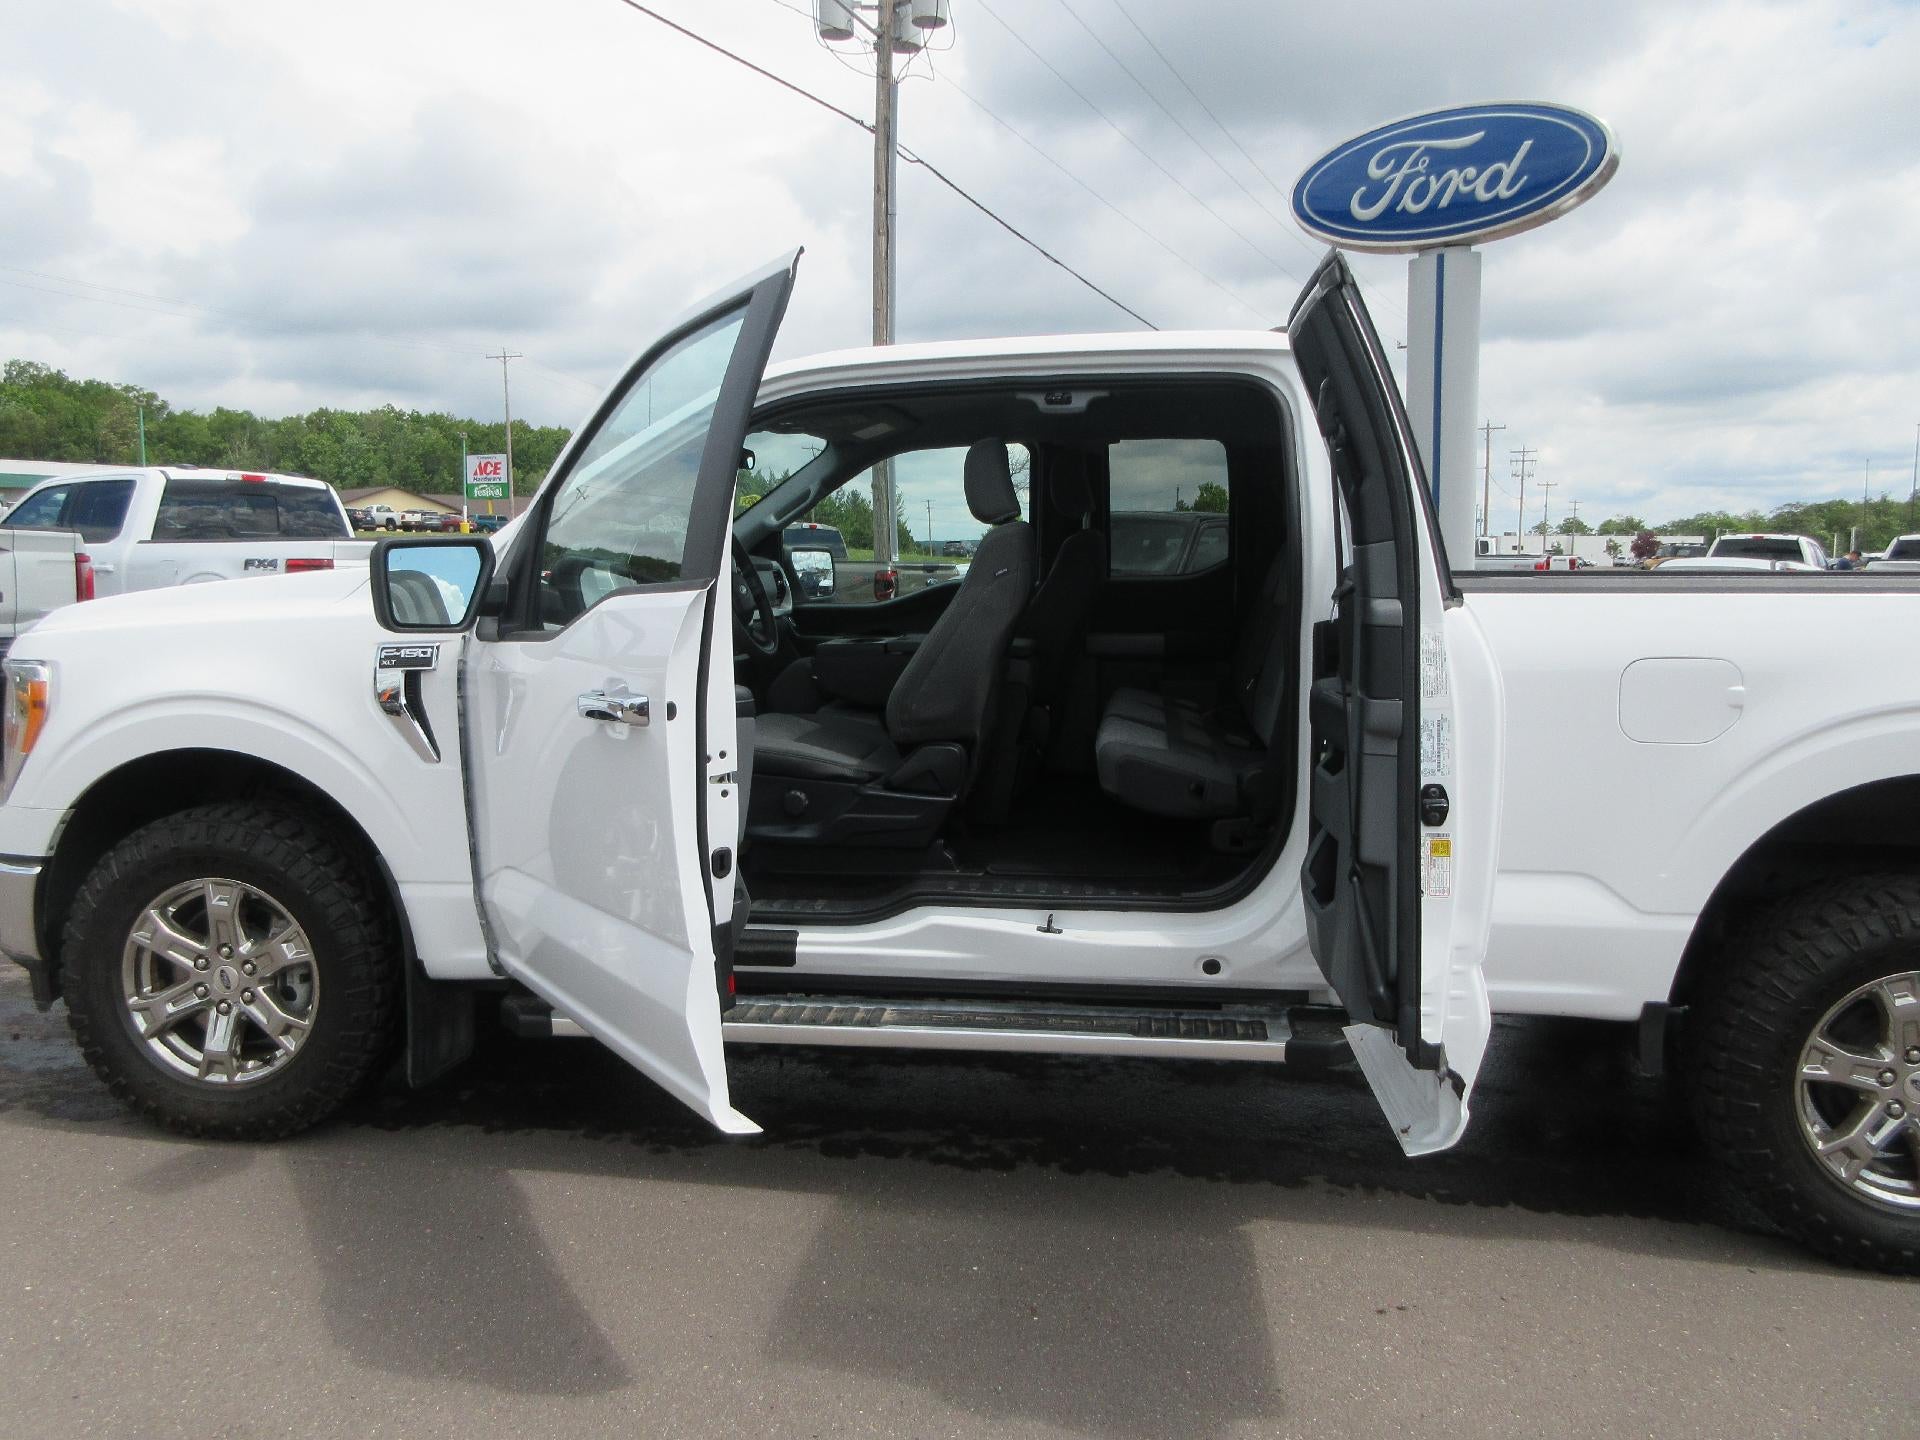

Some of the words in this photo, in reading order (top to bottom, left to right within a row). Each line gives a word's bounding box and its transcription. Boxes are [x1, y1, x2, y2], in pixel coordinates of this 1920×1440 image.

[1350, 131, 1534, 221] Ford
[473, 460, 502, 476] ACE
[244, 559, 278, 570] FX4
[381, 648, 432, 658] F-150
